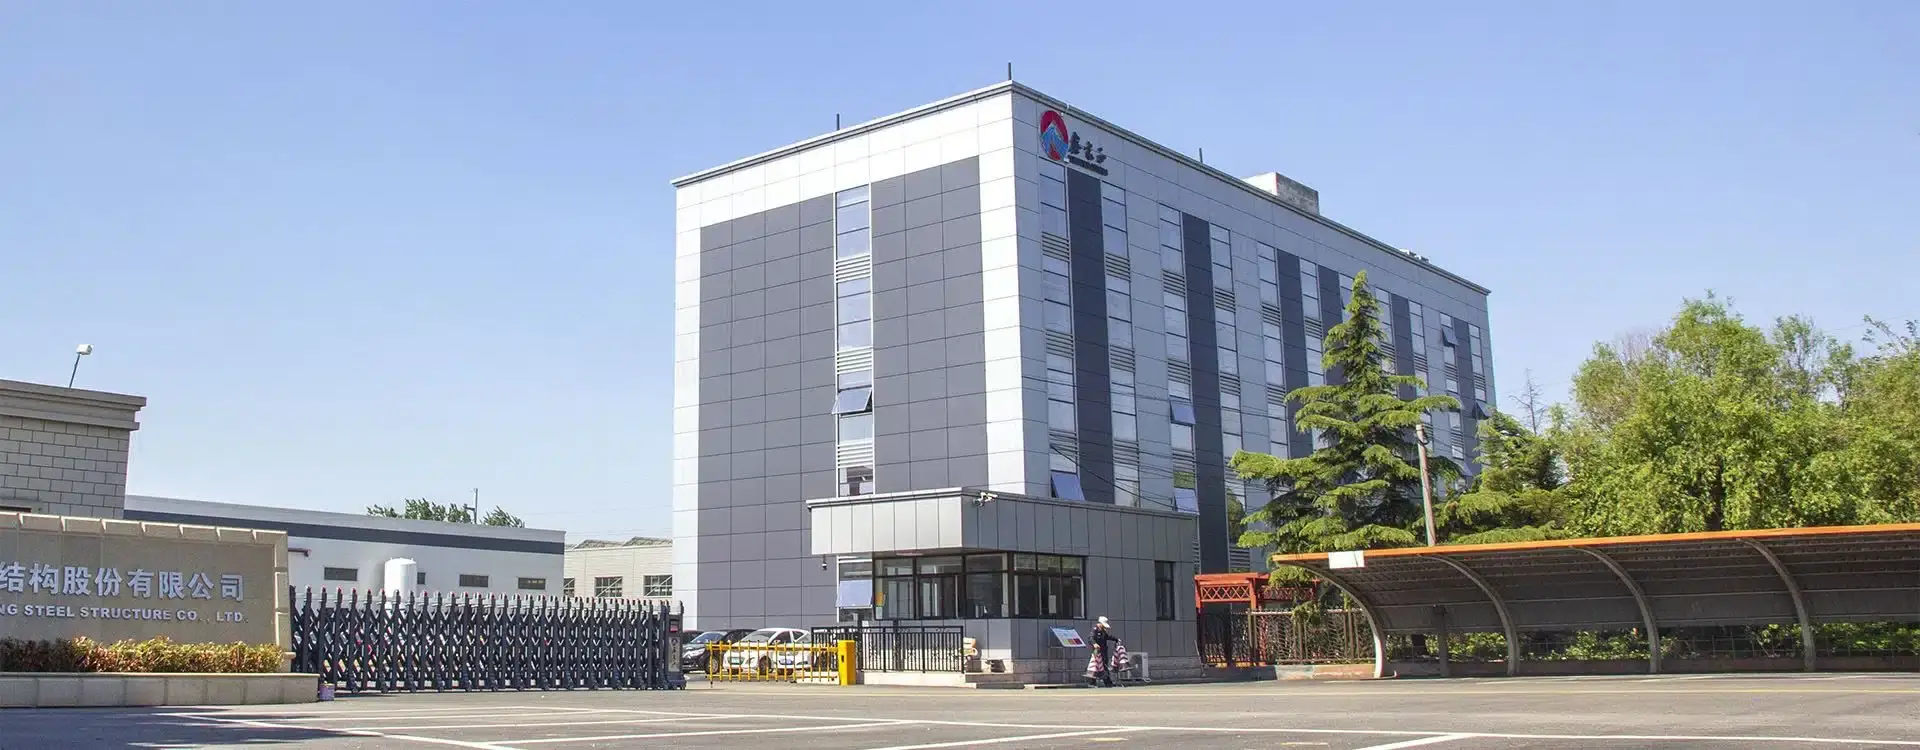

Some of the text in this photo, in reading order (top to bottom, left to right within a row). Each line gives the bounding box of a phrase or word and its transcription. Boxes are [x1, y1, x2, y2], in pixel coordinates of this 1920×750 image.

[0, 561, 244, 601] 结构股份有限公司
[24, 605, 75, 618] STEEL
[80, 607, 171, 620] STRUCTURE
